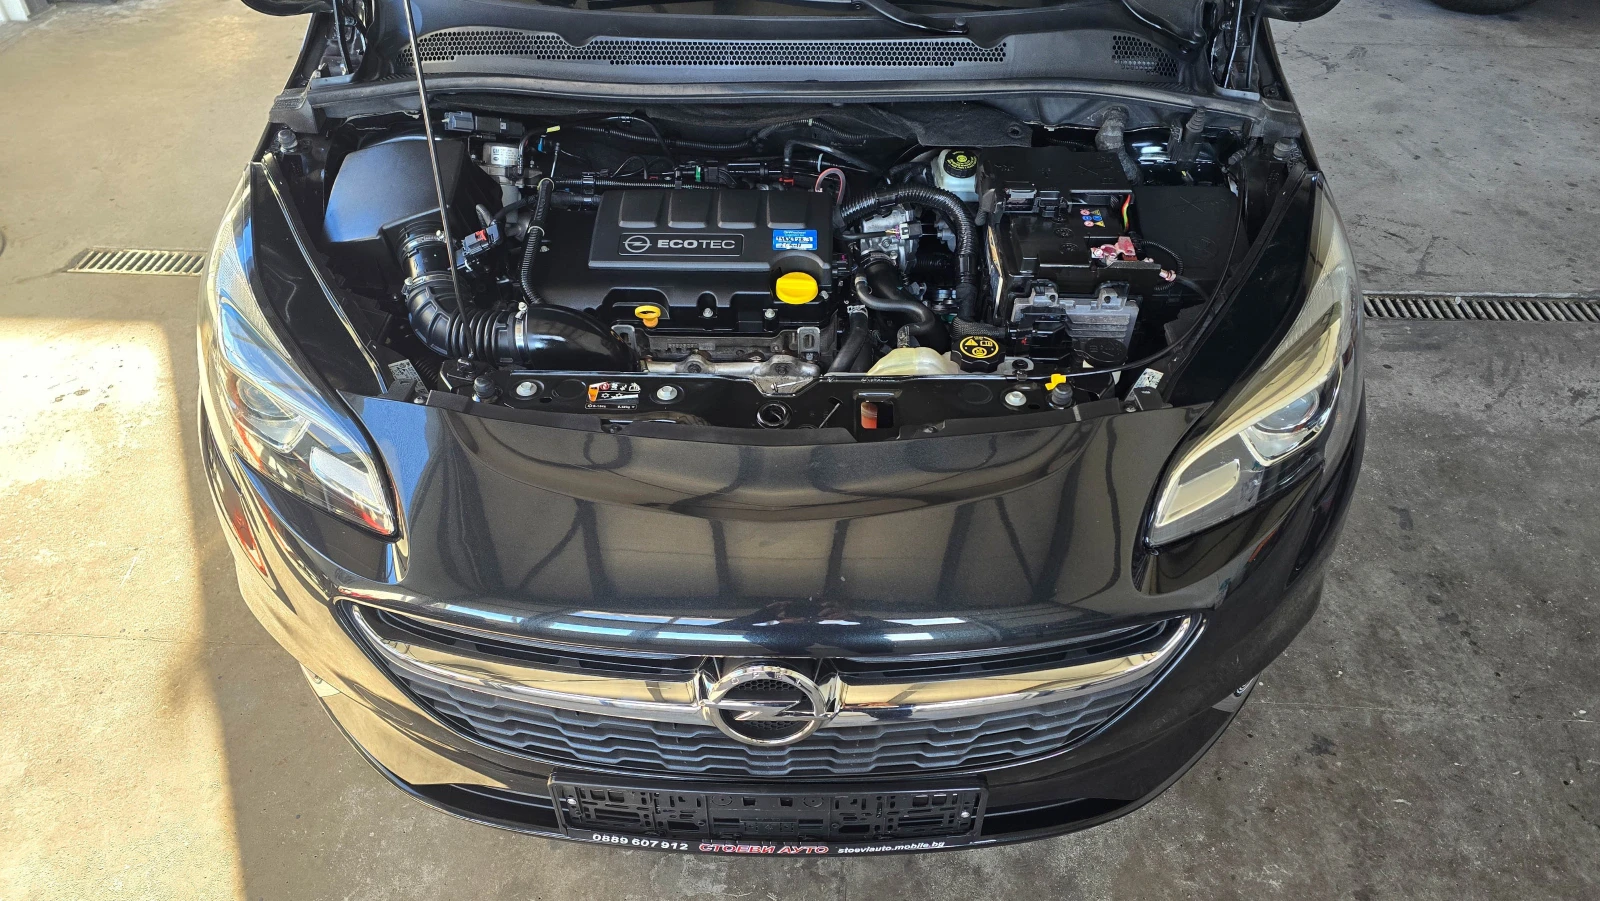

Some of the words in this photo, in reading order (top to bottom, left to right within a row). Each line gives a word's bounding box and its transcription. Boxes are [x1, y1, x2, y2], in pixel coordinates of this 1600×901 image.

[657, 239, 736, 249] ECOTEC
[592, 833, 629, 845] 0889
[631, 838, 659, 848] 607
[661, 840, 689, 850] 912
[837, 841, 945, 854] stoeviauto.mobile.bg
[699, 843, 775, 854] СТОЕВИ
[777, 845, 829, 854] АУТО
